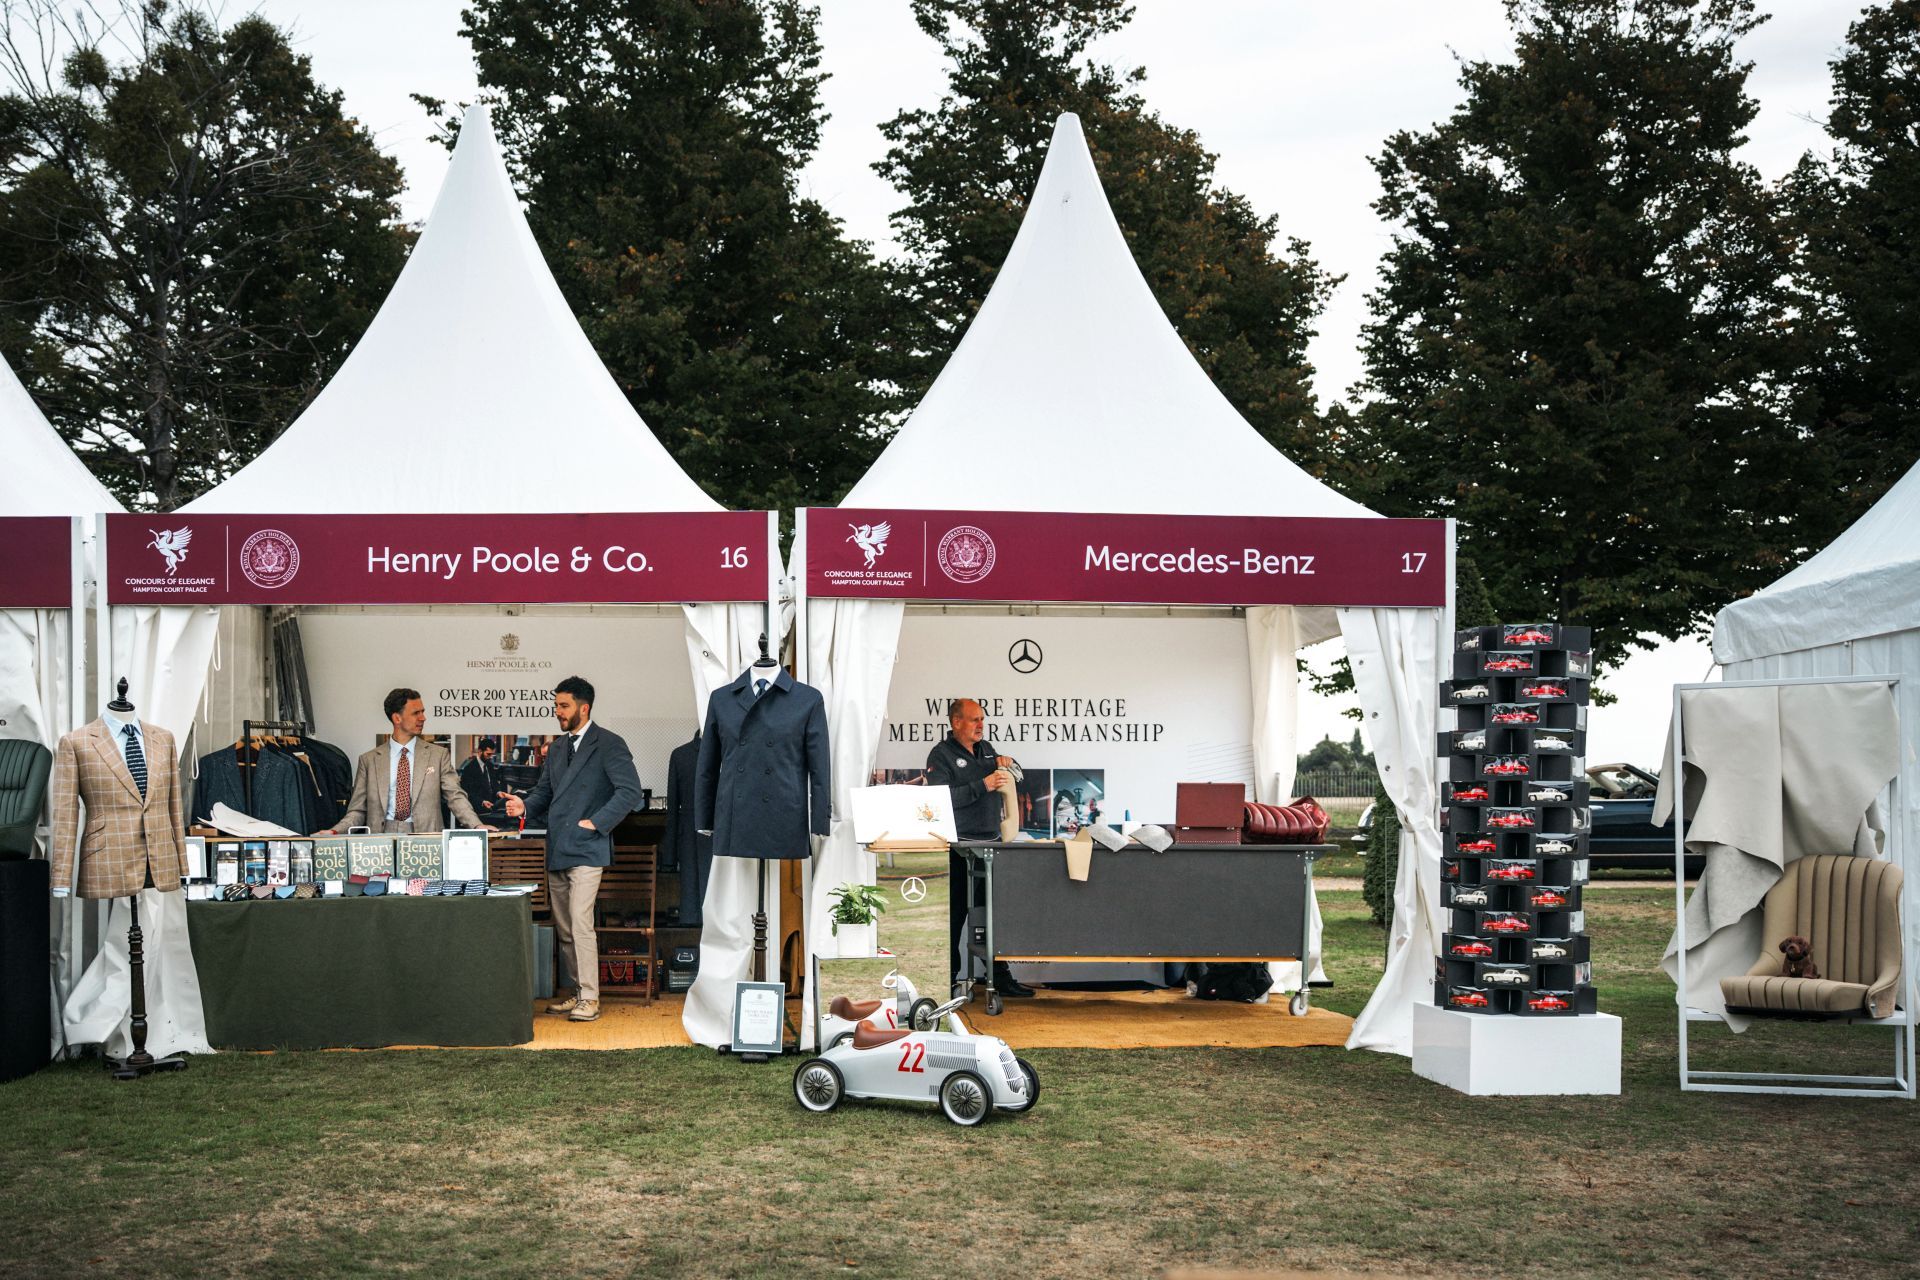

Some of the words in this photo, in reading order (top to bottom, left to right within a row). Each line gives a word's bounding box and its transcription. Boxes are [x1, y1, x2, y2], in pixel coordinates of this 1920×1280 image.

[367, 546, 462, 580] Henry
[472, 546, 560, 573] Poole
[570, 546, 592, 573] &
[602, 545, 654, 573] Co.
[720, 546, 749, 569] 16
[1084, 545, 1315, 575] Mercedes-Benz
[1401, 552, 1427, 573] 17
[876, 571, 912, 579] ELEGANCE
[499, 660, 529, 668] POOLE
[439, 688, 480, 701] OVER
[484, 688, 506, 701] 200
[509, 688, 557, 701] YEARS
[434, 706, 503, 718] BESPOKE
[925, 698, 1004, 717] WRE
[1015, 698, 1127, 717] HERITAGE
[988, 723, 1164, 742] RAFTSMANSHIP
[315, 846, 346, 857] enry
[351, 842, 392, 856] Henry
[400, 840, 440, 855] Henry
[315, 854, 346, 868] oole
[352, 853, 392, 867] Poole
[400, 853, 440, 866] Poole
[324, 868, 346, 880] Co.
[400, 865, 416, 877] &
[418, 866, 440, 878] Co.
[898, 1042, 926, 1073] 22
